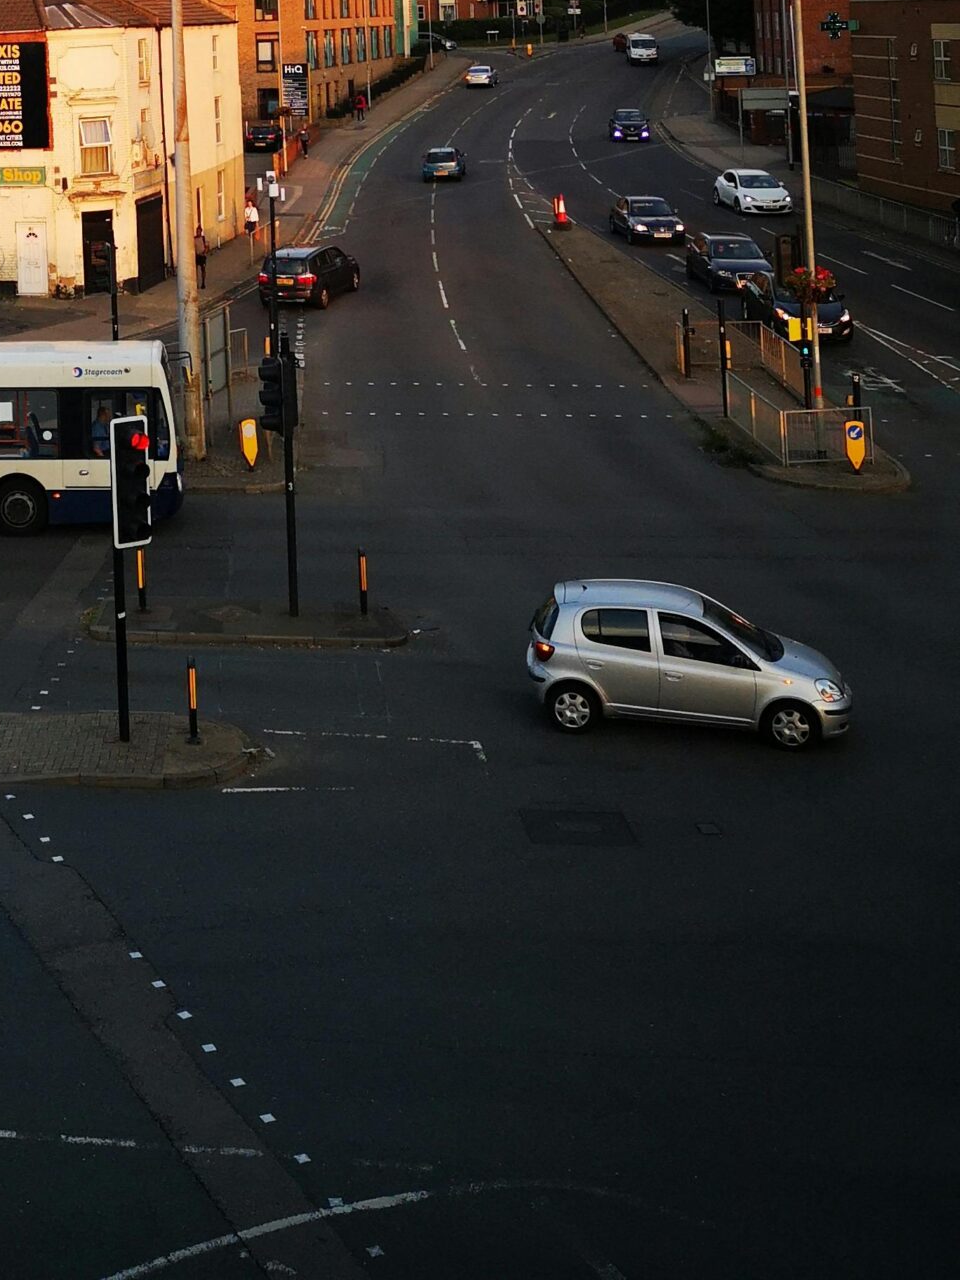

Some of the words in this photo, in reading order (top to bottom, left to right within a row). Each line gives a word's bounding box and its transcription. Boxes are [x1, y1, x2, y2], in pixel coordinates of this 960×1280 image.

[284, 65, 303, 74] HiQ
[3, 168, 41, 184] Shop
[84, 367, 123, 377] Stagecoach
[287, 482, 294, 492] 3
